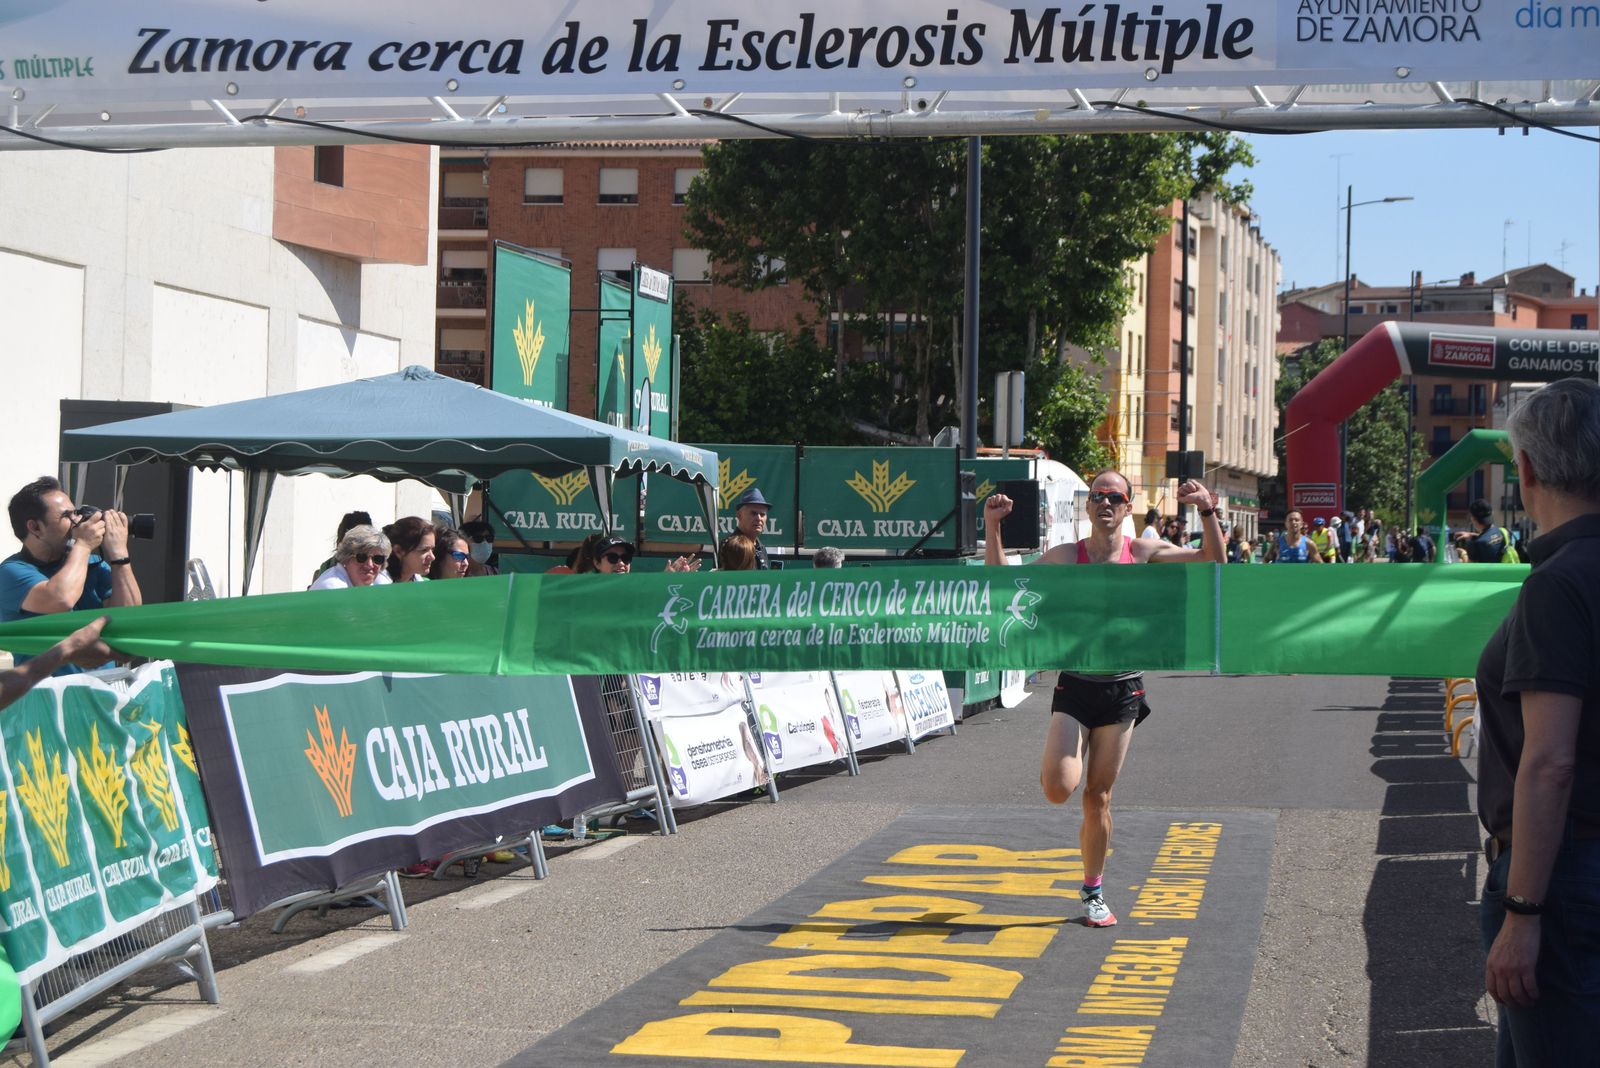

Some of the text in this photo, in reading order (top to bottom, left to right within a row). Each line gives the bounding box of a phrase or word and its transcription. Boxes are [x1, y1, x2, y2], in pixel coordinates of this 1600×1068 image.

[1297, 0, 1482, 16] AYUNTAMIENTO
[1515, 1, 1562, 28] dia
[127, 3, 1254, 75] Zamora cerca de la Esclerosis Múltiple
[1297, 15, 1482, 42] DE ZAMORA
[14, 54, 94, 79] MÚLTIPLE
[1444, 350, 1491, 363] ZAMORA
[1509, 338, 1543, 352] CON
[1547, 339, 1565, 353] EL
[1508, 356, 1584, 373] GANAMOS
[503, 510, 550, 529] CAJA
[657, 515, 706, 532] CAJA
[817, 519, 945, 538] CAJA RURAL
[697, 580, 992, 621] CARRERA del CERCO de ZAMORA
[696, 618, 990, 649] Zamora cerca de la Esclerosis Múltiple
[903, 681, 947, 721] OCEANIC
[365, 708, 548, 801] CAJA RURAL
[1150, 822, 1223, 875] INTERIORES
[1127, 869, 1207, 919] DISEÑO
[609, 843, 1113, 1067] PIDEPAR
[1077, 937, 1190, 1017] INTEGRAL
